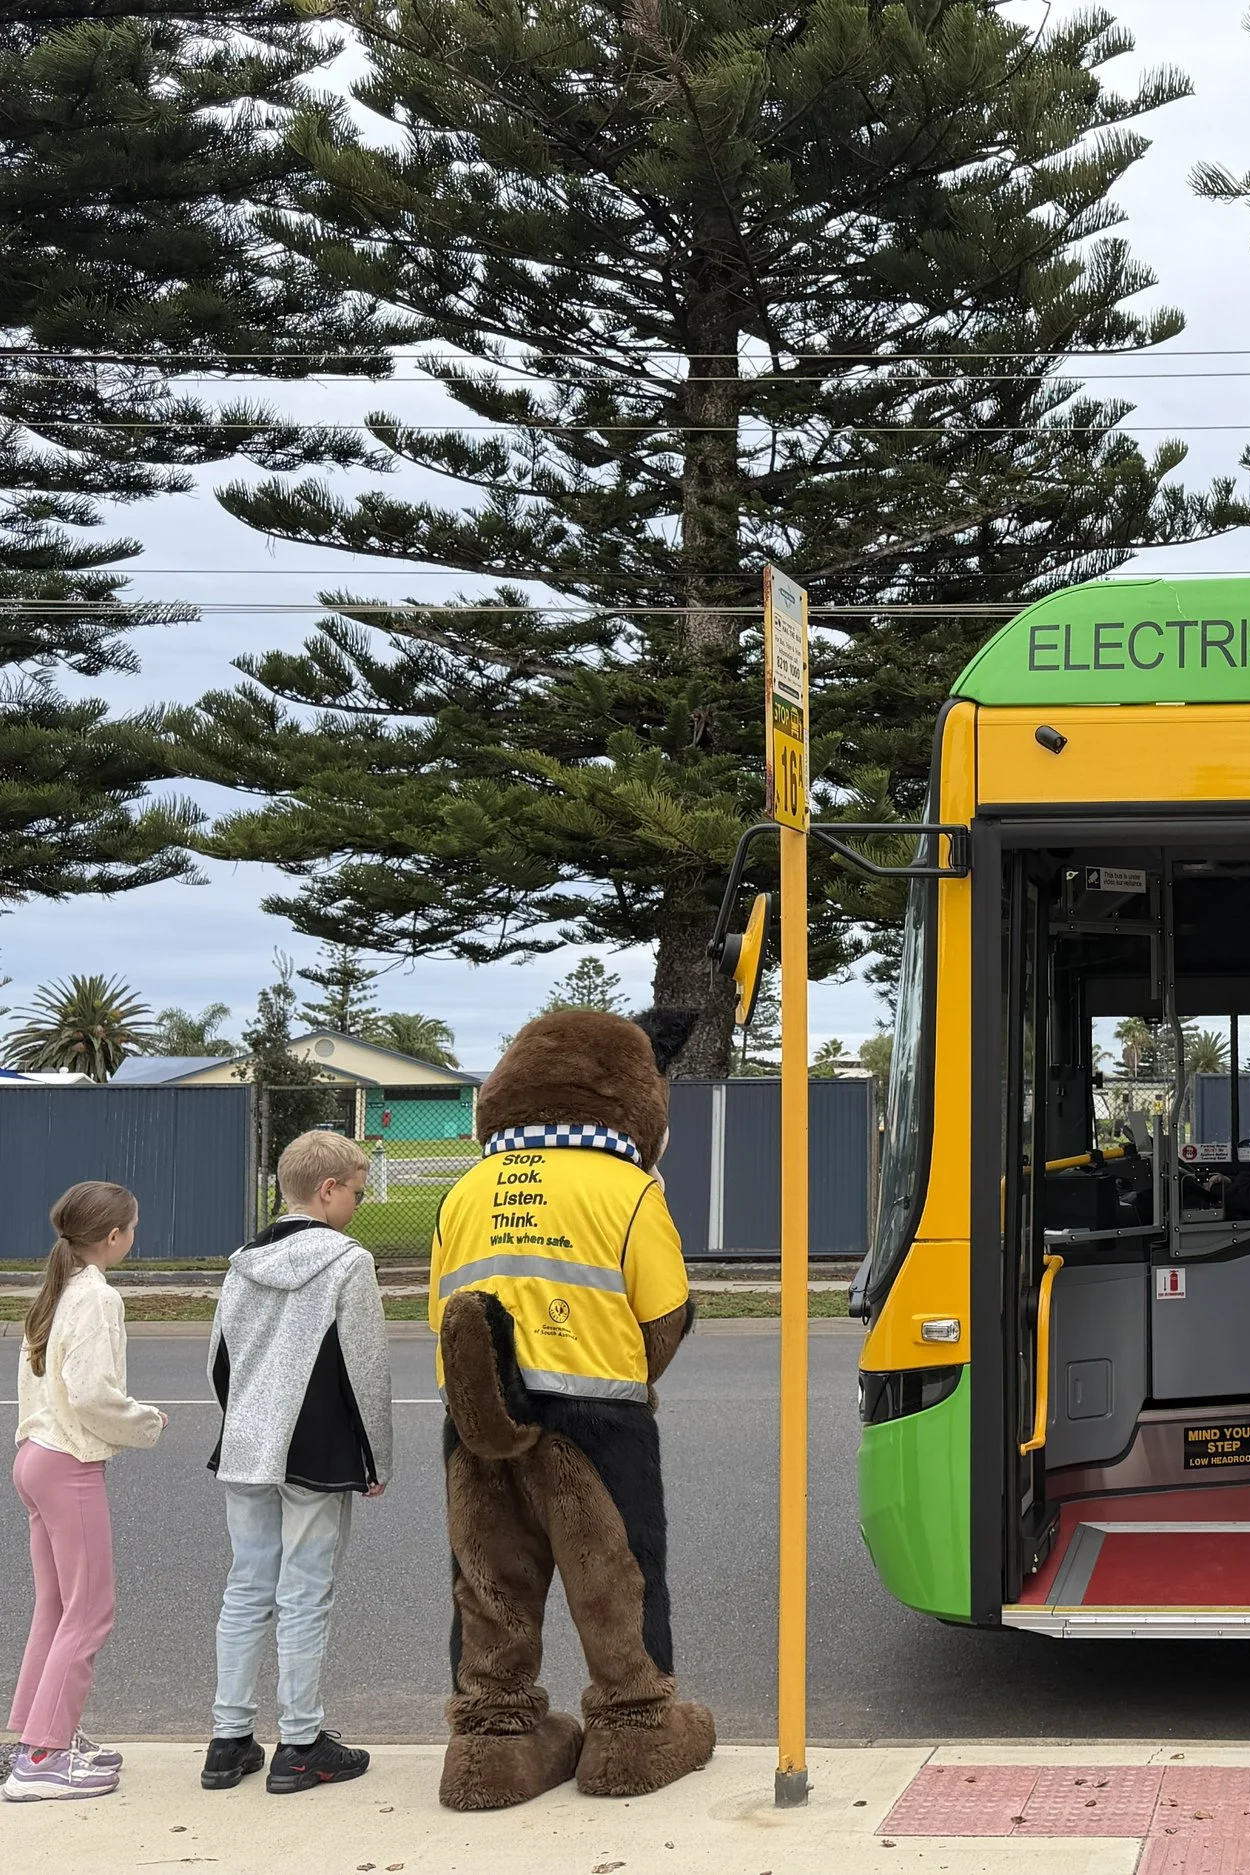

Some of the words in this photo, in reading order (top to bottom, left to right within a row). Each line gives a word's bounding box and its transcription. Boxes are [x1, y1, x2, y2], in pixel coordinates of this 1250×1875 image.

[774, 702, 789, 726] STOP
[502, 1154, 546, 1166] Stop.
[497, 1170, 542, 1185] Look.
[494, 1191, 547, 1207] Listen.
[492, 1212, 538, 1229] Think.
[490, 1233, 514, 1246] Walk
[517, 1233, 544, 1245] when
[546, 1236, 573, 1248] safe.
[1188, 1430, 1220, 1441] MIND
[1207, 1441, 1241, 1453] STEP
[1190, 1458, 1209, 1466] LOW
